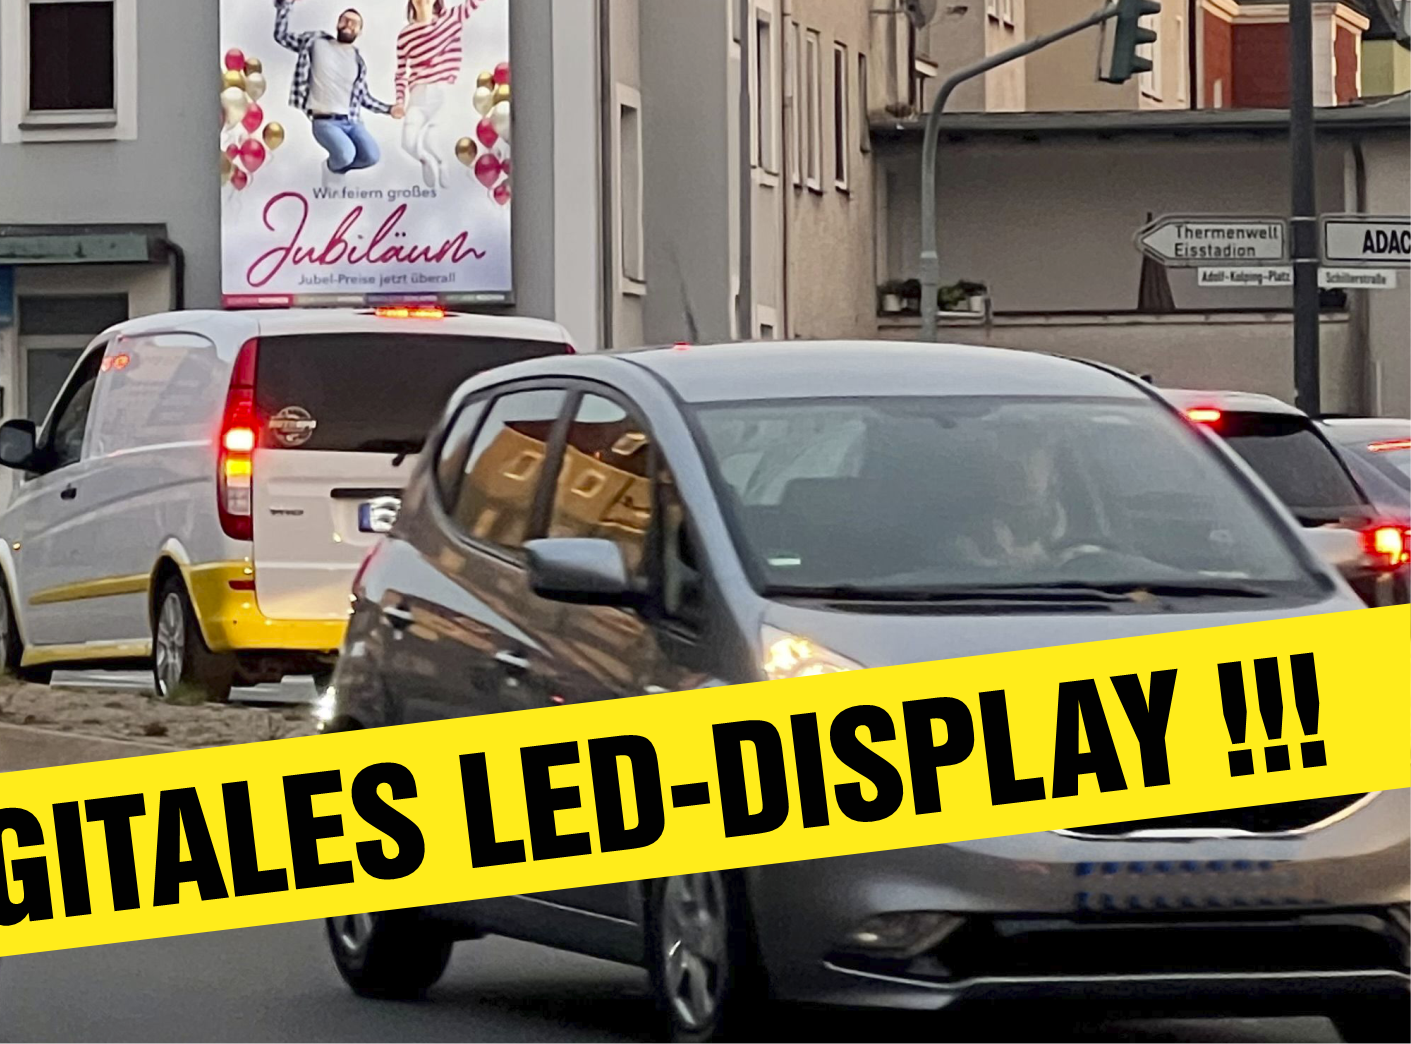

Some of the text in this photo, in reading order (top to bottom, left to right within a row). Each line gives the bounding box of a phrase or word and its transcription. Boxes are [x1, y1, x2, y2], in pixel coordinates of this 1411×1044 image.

[312, 185, 437, 202] Wir feiern großes
[246, 191, 487, 288] Jubiläum
[1175, 225, 1278, 240] Thermenwelt
[1362, 229, 1411, 254] ADAC
[1174, 243, 1256, 258] Eisstadion
[297, 272, 456, 287] Jubel-Preise jetzt überall
[1201, 270, 1291, 286] Adolf-Kolping-Platz
